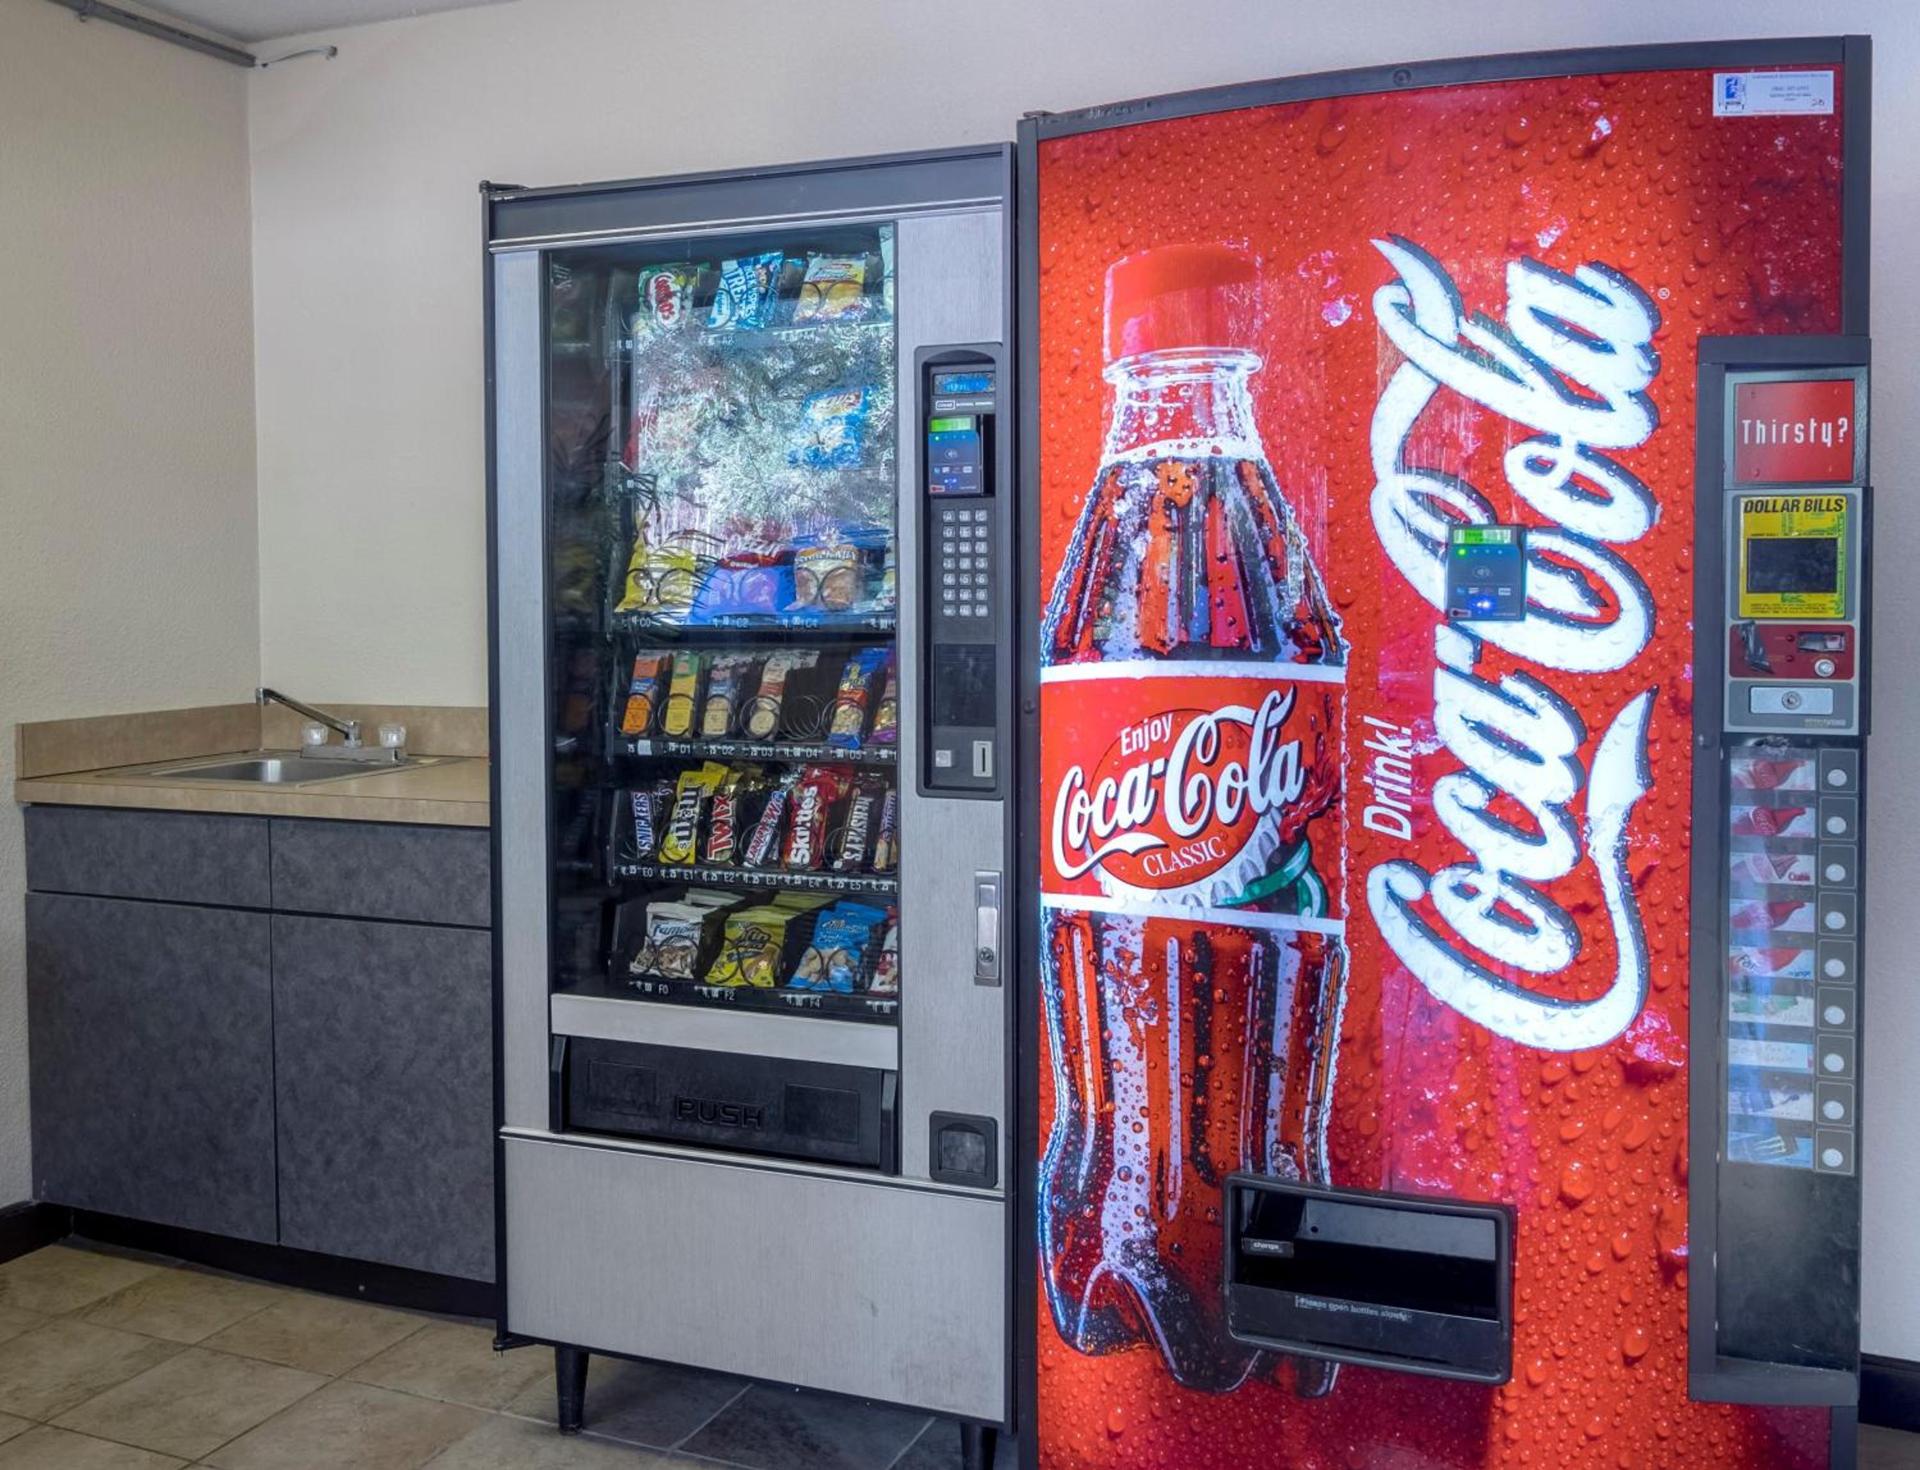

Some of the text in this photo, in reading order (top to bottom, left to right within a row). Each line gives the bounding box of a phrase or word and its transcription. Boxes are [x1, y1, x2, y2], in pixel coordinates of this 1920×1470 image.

[1742, 416, 1848, 448] Thirsty?
[1743, 498, 1844, 513] DOLLAR BILLS
[1366, 235, 1662, 1052] Coca-Cola
[1120, 713, 1173, 756] Enjoy
[1052, 683, 1304, 879] Coca-Cola
[1362, 715, 1412, 840] Drink!
[632, 790, 654, 851] SNICKERS
[1142, 836, 1226, 877] CLASSIC
[674, 1096, 766, 1131] PUSH
